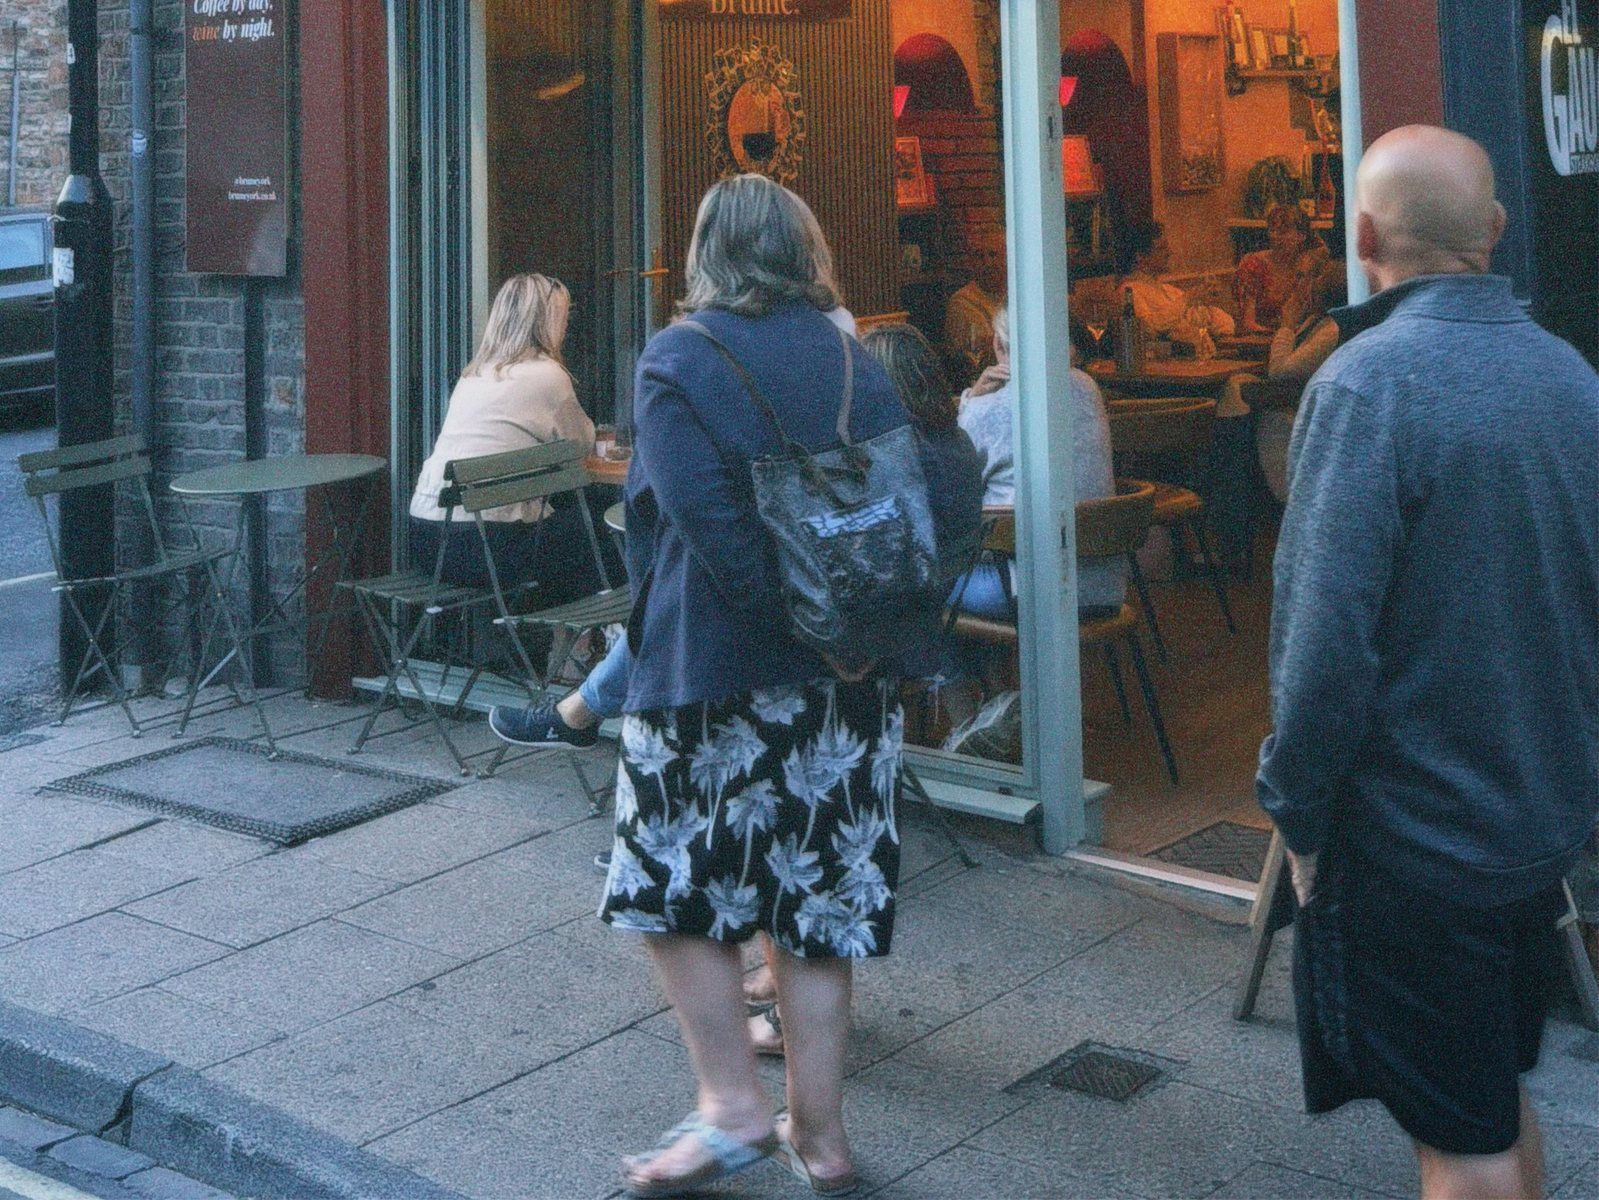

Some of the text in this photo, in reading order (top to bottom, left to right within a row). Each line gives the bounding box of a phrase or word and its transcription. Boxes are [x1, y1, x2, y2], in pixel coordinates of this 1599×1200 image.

[222, 19, 238, 43] by
[240, 17, 275, 41] night.
[1541, 14, 1599, 176] GAU
